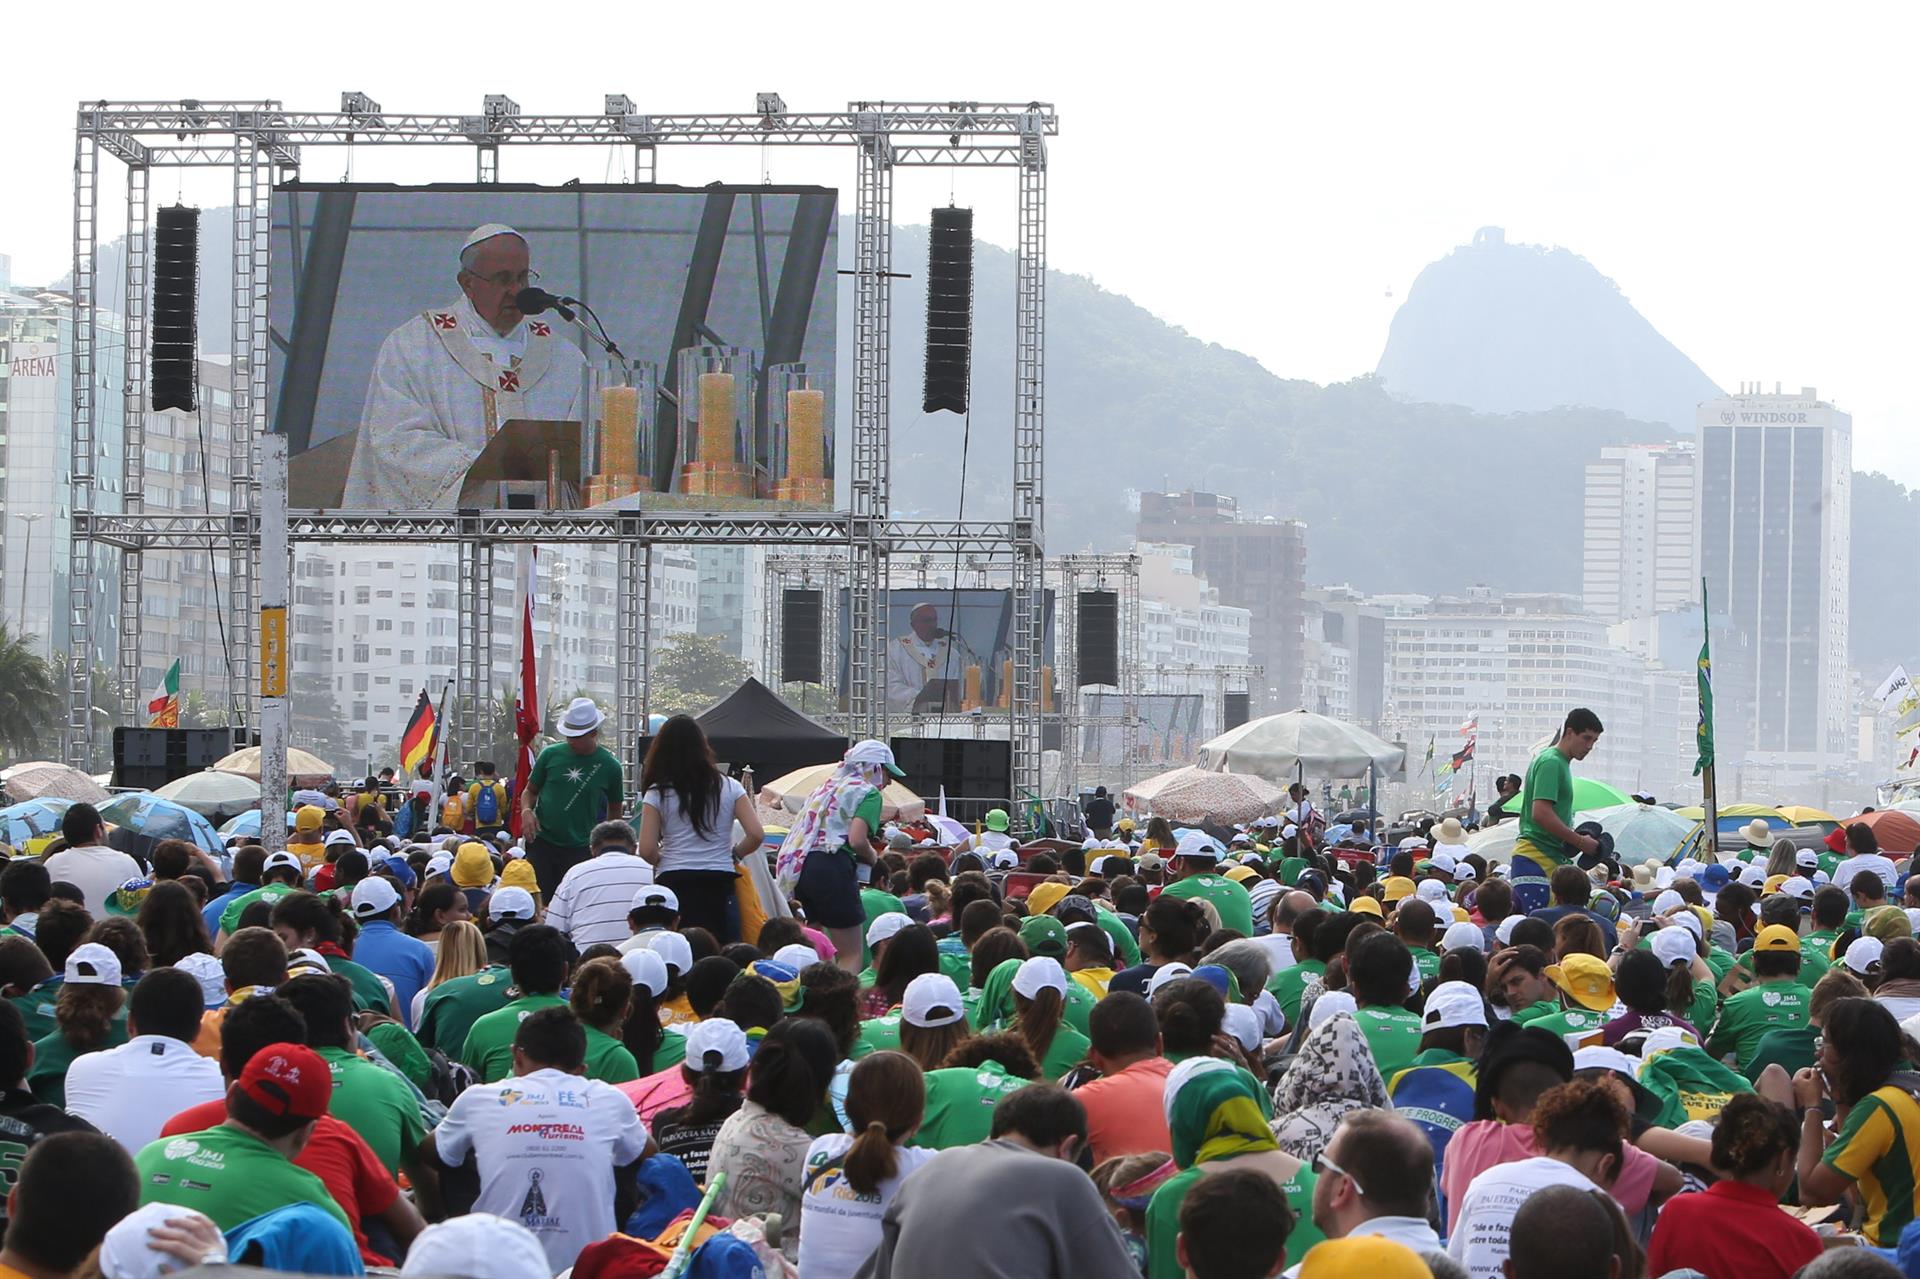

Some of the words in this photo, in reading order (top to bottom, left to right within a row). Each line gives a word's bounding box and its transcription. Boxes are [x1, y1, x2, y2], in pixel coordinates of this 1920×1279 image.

[11, 356, 56, 377] ARENA
[1740, 412, 1807, 424] WINDSOR
[506, 1123, 584, 1135] MONTREAL
[661, 1130, 699, 1145] PARÓQUIA
[197, 1149, 225, 1161] JMJ
[1488, 1224, 1494, 1232] e
[1488, 1236, 1508, 1245] toda
